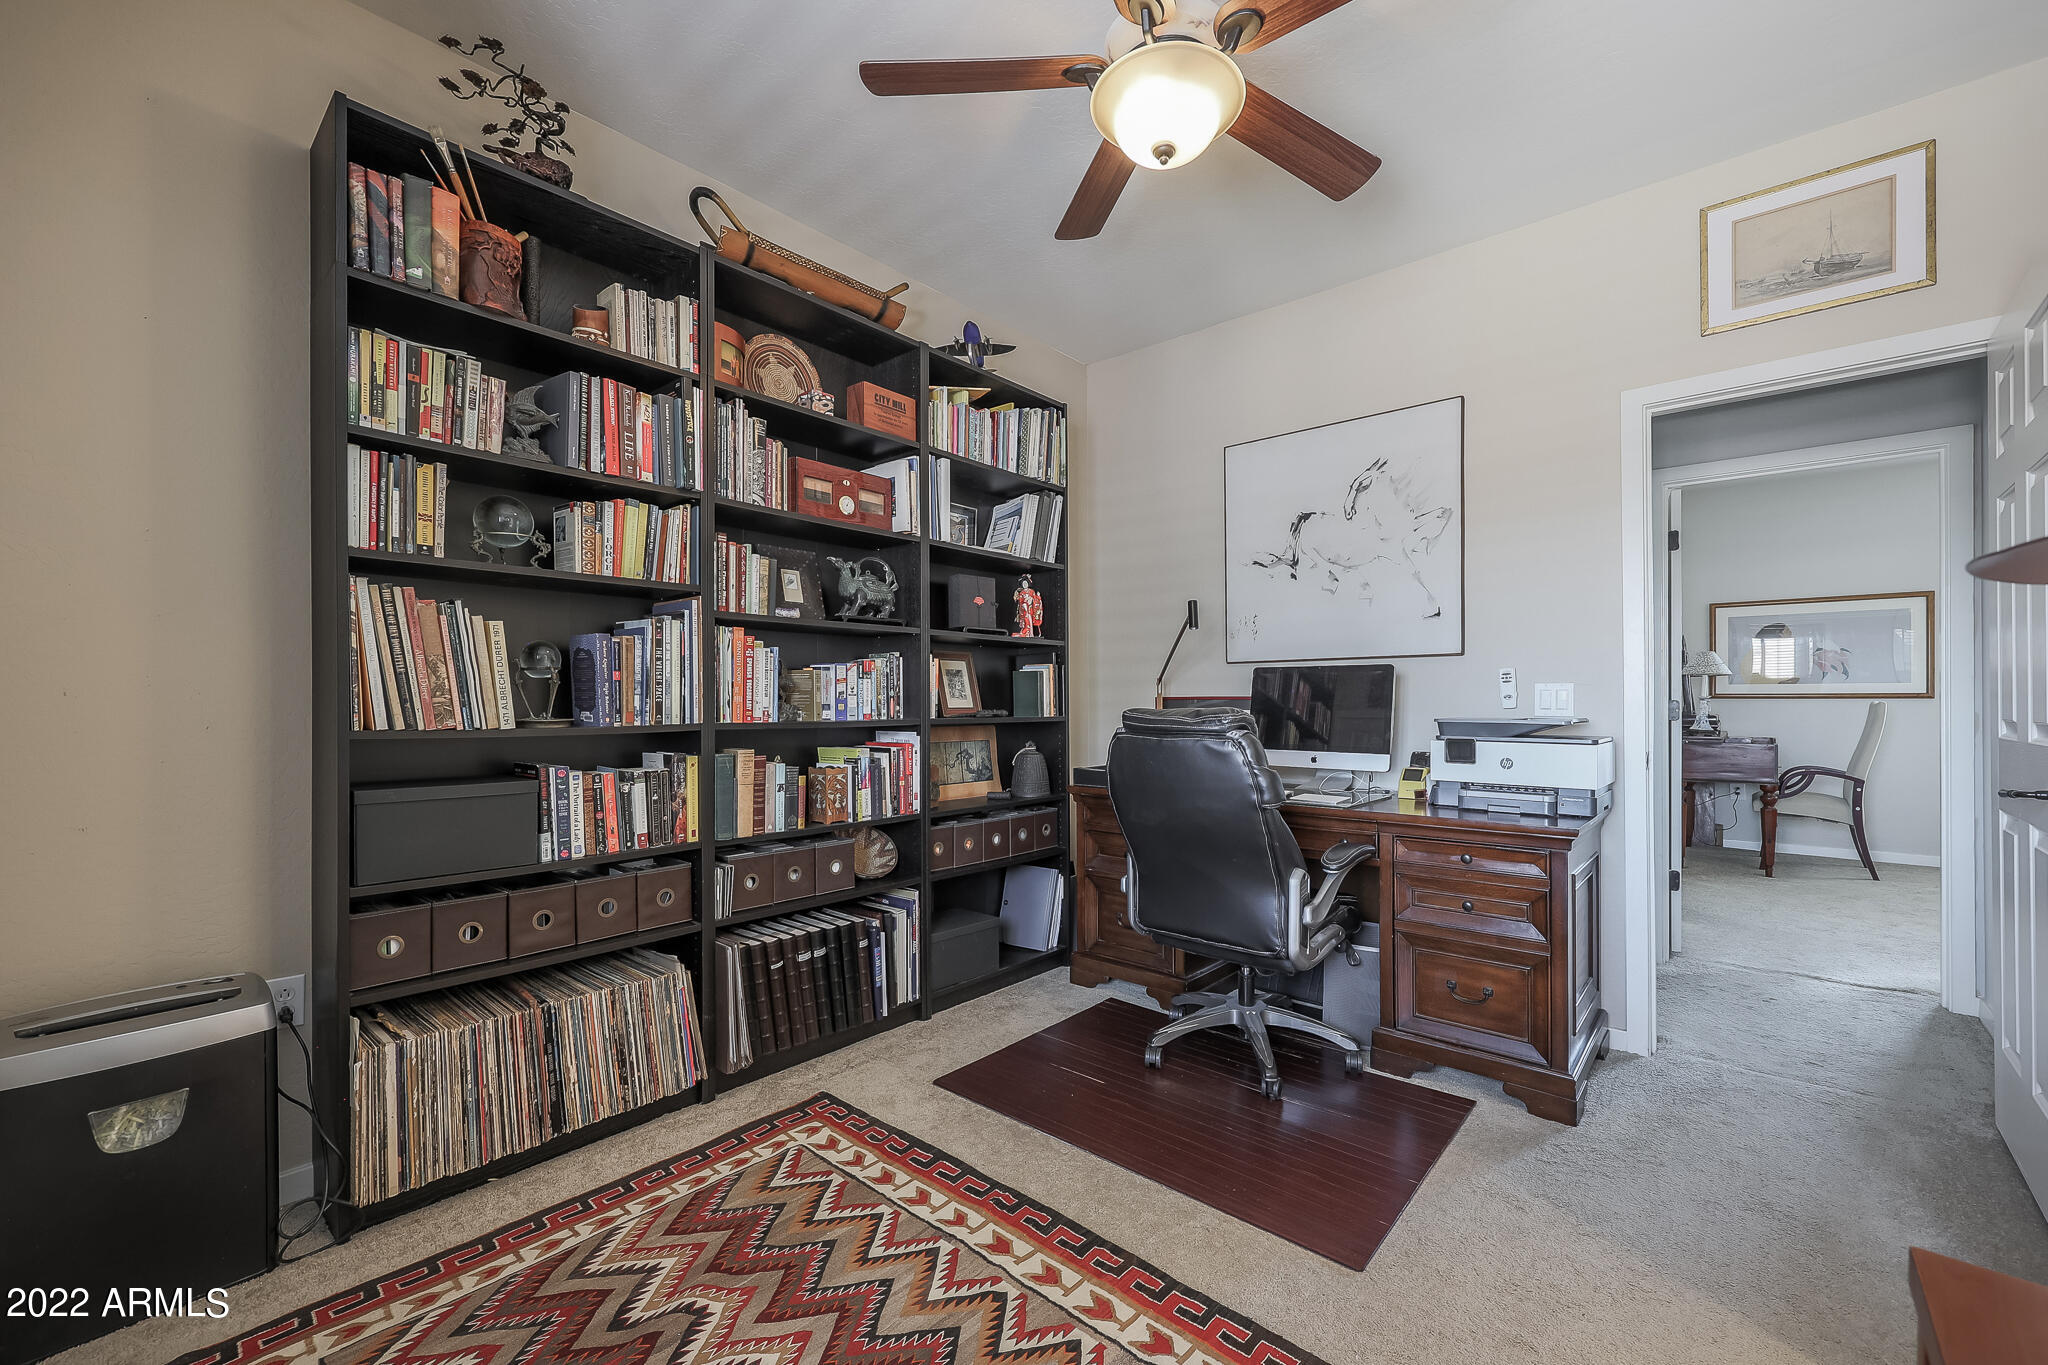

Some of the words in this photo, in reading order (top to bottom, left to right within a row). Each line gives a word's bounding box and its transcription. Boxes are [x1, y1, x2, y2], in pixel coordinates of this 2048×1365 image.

[874, 392, 890, 406] CITY
[684, 400, 694, 432] WOODSTOCK
[624, 431, 634, 461] LIFE
[436, 513, 444, 528] Purple
[382, 590, 392, 600] THE
[384, 603, 393, 614] ART
[386, 616, 394, 624] OF
[388, 626, 396, 637] BEV
[390, 639, 405, 673] DOOLITTLE
[415, 649, 424, 678] Albrecht
[498, 670, 508, 710] ALBRECHT
[1500, 758, 1513, 770] hp
[572, 828, 580, 843] Lady
